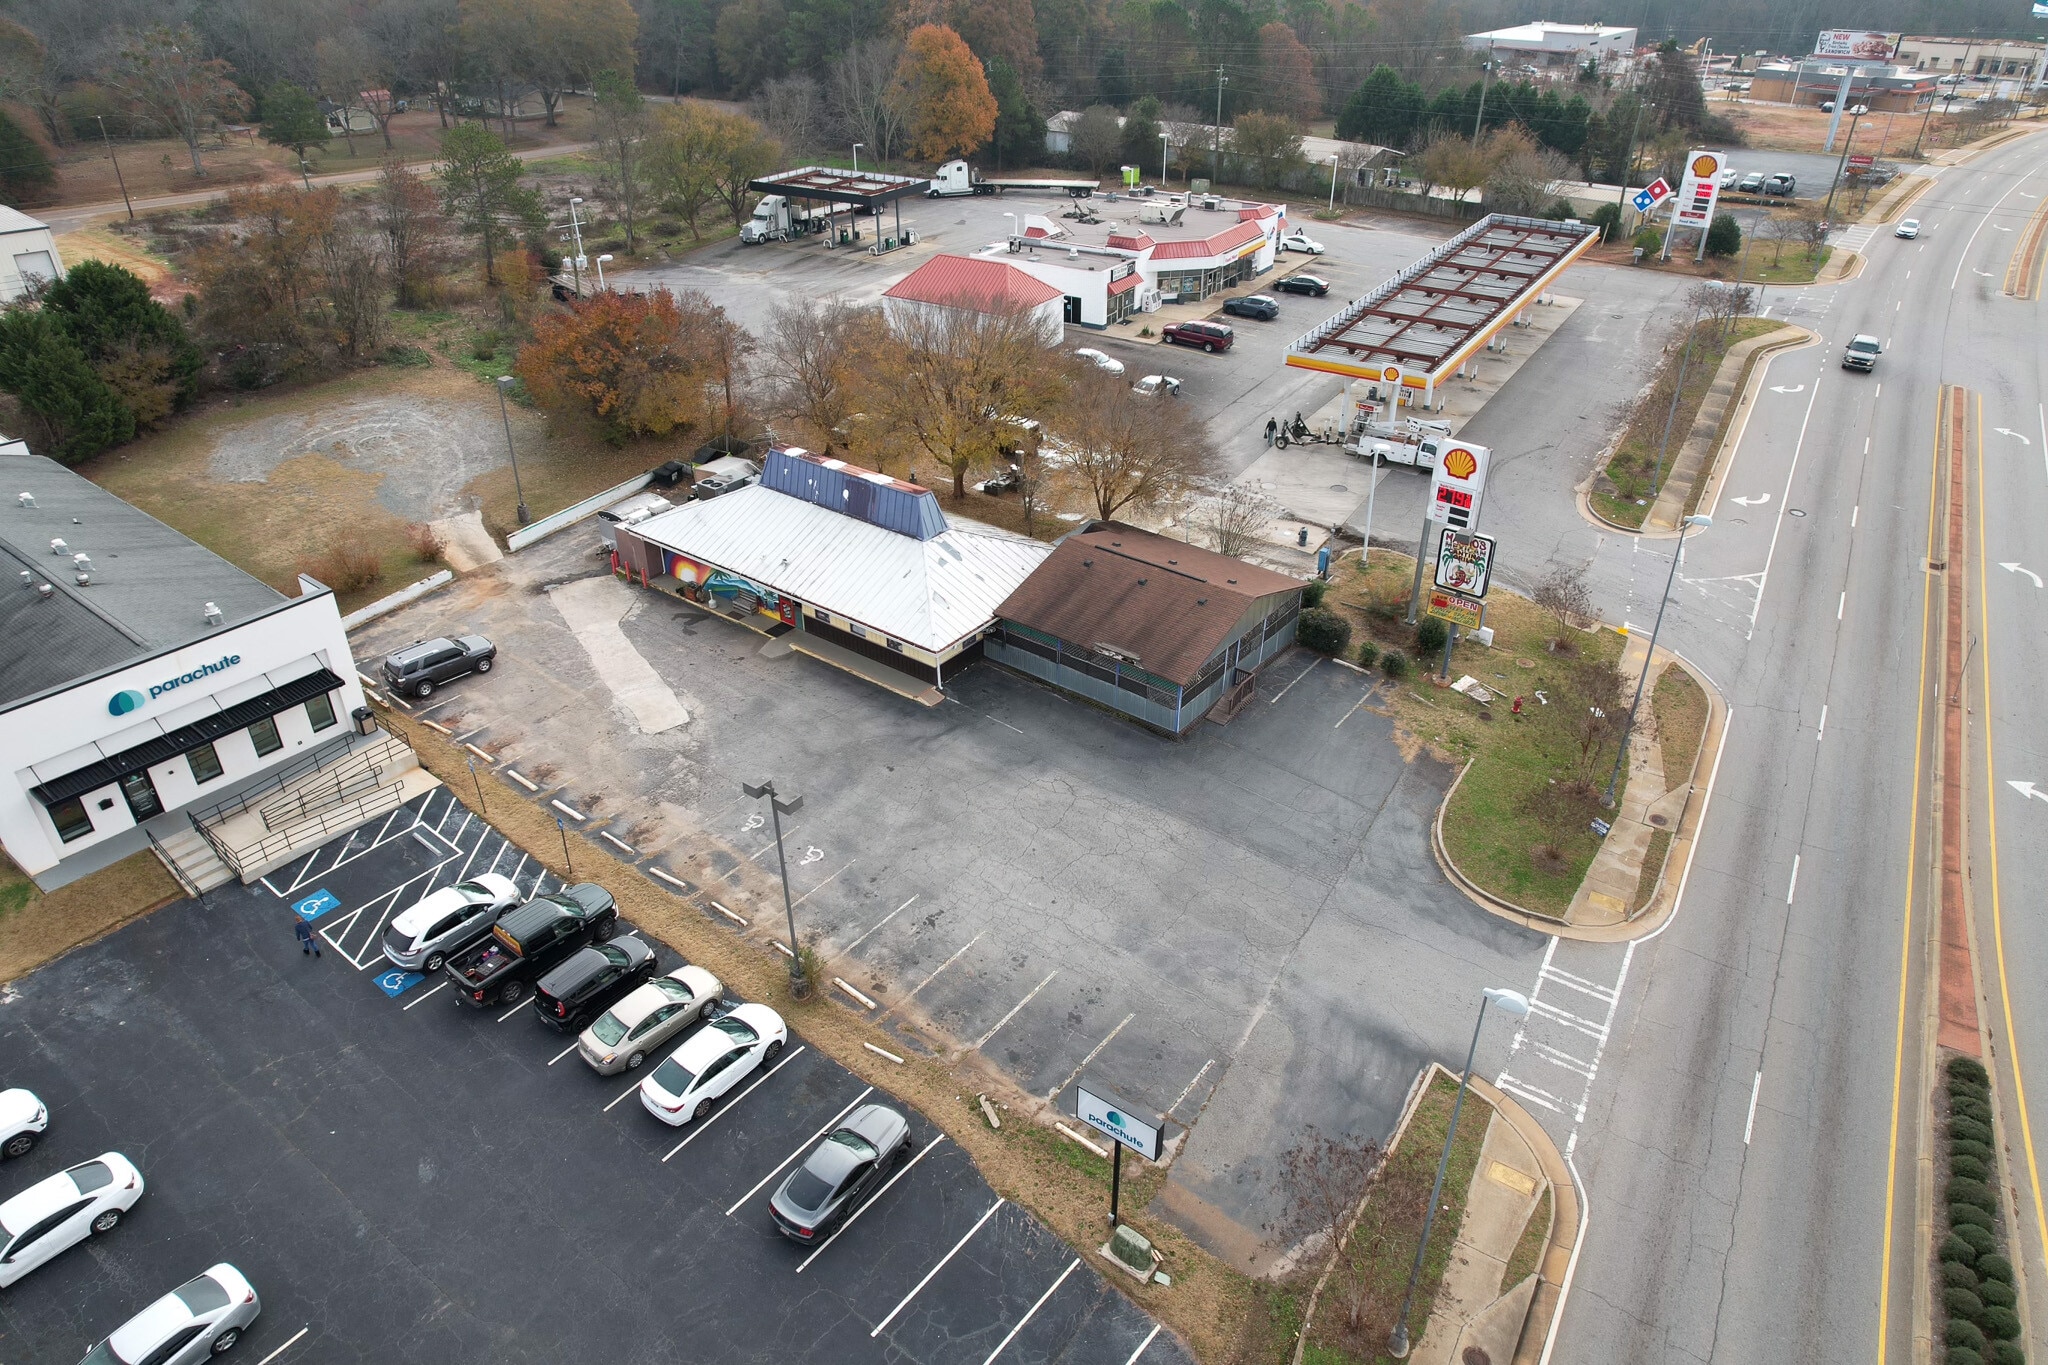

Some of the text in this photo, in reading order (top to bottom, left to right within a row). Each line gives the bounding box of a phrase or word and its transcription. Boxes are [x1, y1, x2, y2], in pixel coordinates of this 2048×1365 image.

[1449, 549, 1481, 560] CANTINA
[1448, 597, 1478, 610] OPEN
[149, 654, 241, 699] parachute
[1088, 1113, 1143, 1148] parachute
